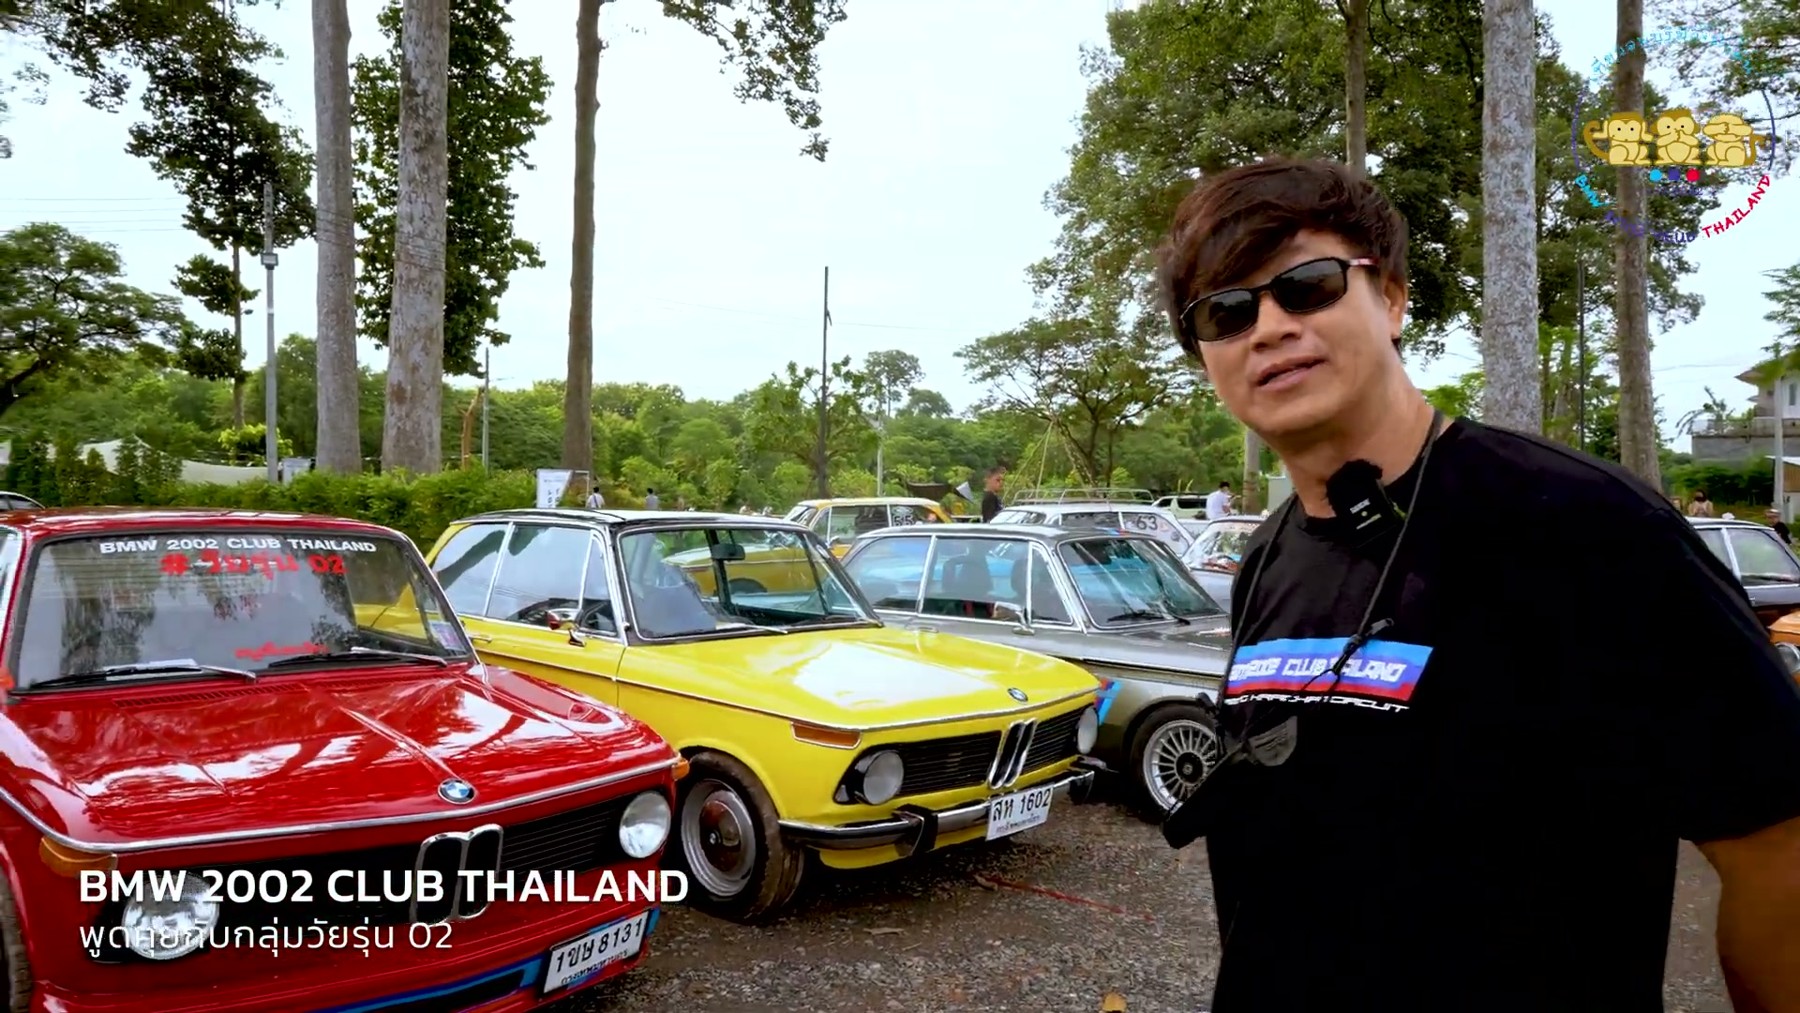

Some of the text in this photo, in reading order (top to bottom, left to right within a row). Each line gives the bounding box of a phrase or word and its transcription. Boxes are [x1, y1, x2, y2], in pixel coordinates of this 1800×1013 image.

[1136, 515, 1158, 530] 63
[99, 538, 377, 554] BMW 2002 CLUB THAILAND
[307, 553, 348, 575] 02
[1330, 656, 1407, 682] TAILAND
[1020, 788, 1051, 815] 1602
[598, 918, 643, 954] 8131
